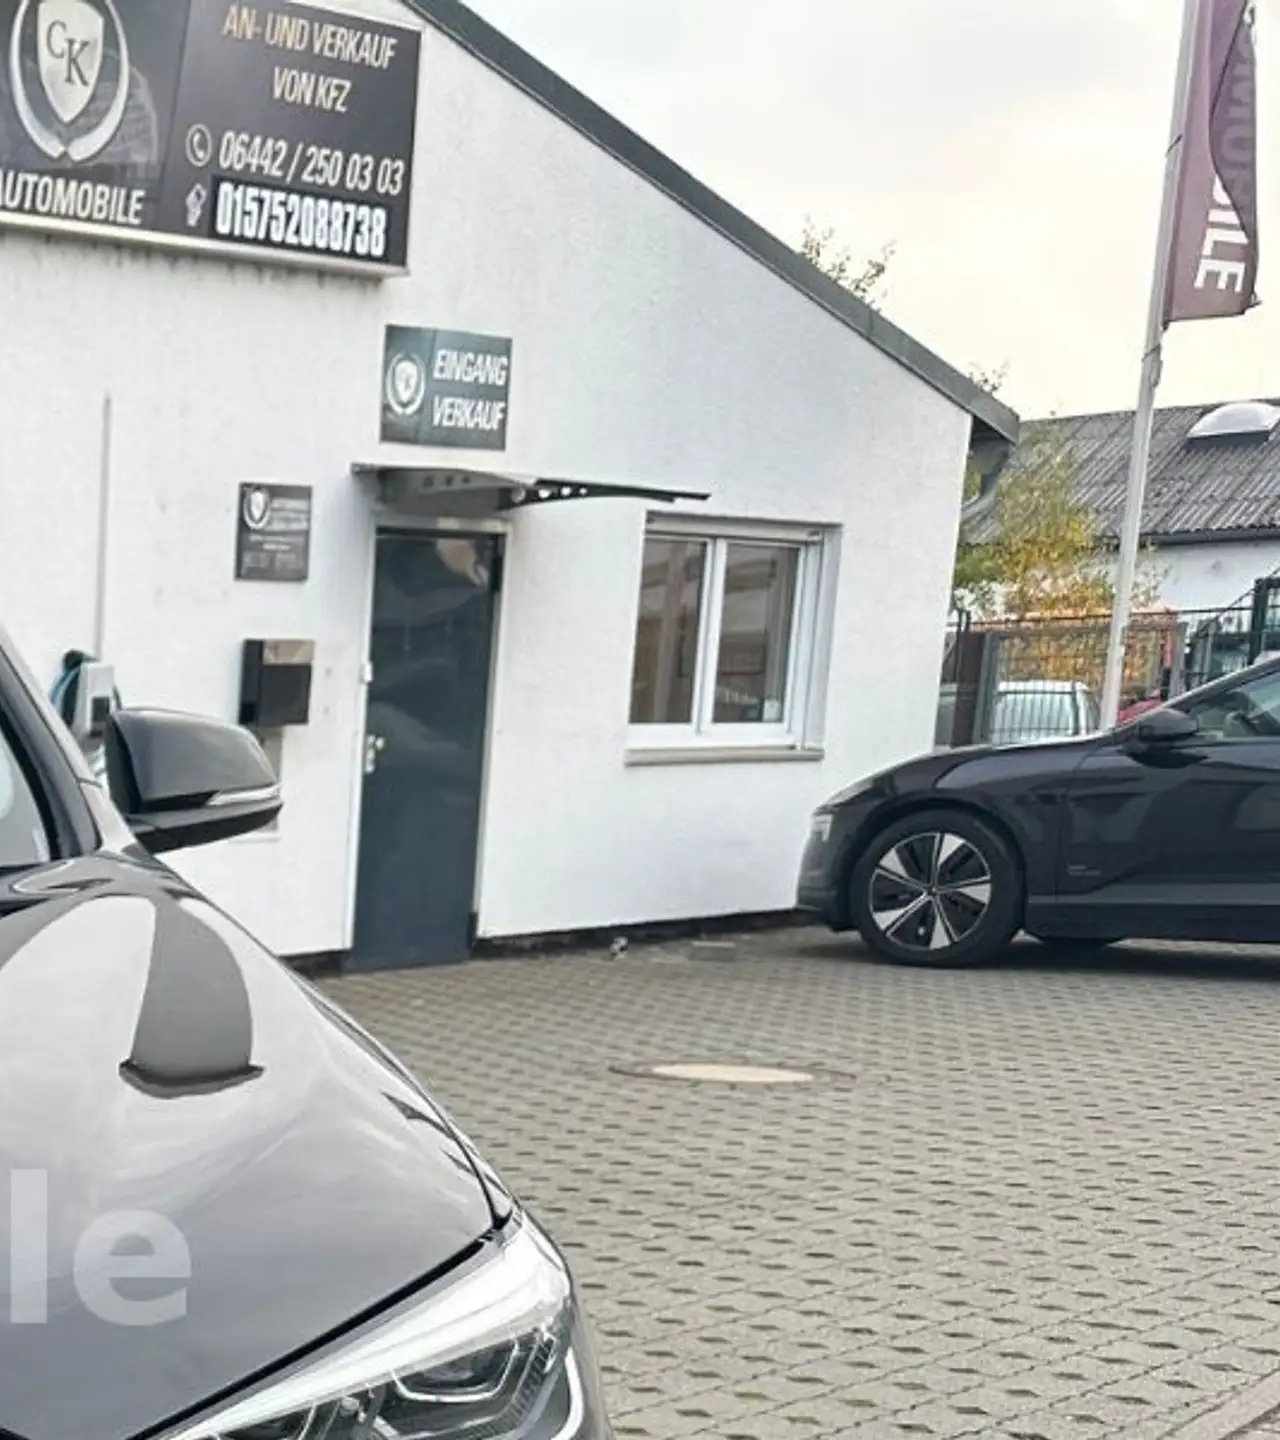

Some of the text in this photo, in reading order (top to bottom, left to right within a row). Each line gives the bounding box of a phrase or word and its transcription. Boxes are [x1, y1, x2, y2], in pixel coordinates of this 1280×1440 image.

[46, 19, 90, 87] CK
[221, 4, 398, 70] AN- UND VERKAUF
[273, 65, 352, 113] VON KFZ
[219, 131, 289, 178] 06442
[301, 145, 343, 188] 250
[345, 152, 374, 192] 03
[377, 157, 405, 196] 03
[215, 181, 388, 257] 015752088738
[433, 349, 508, 386] EINGANG
[432, 395, 506, 431] VERKAUF
